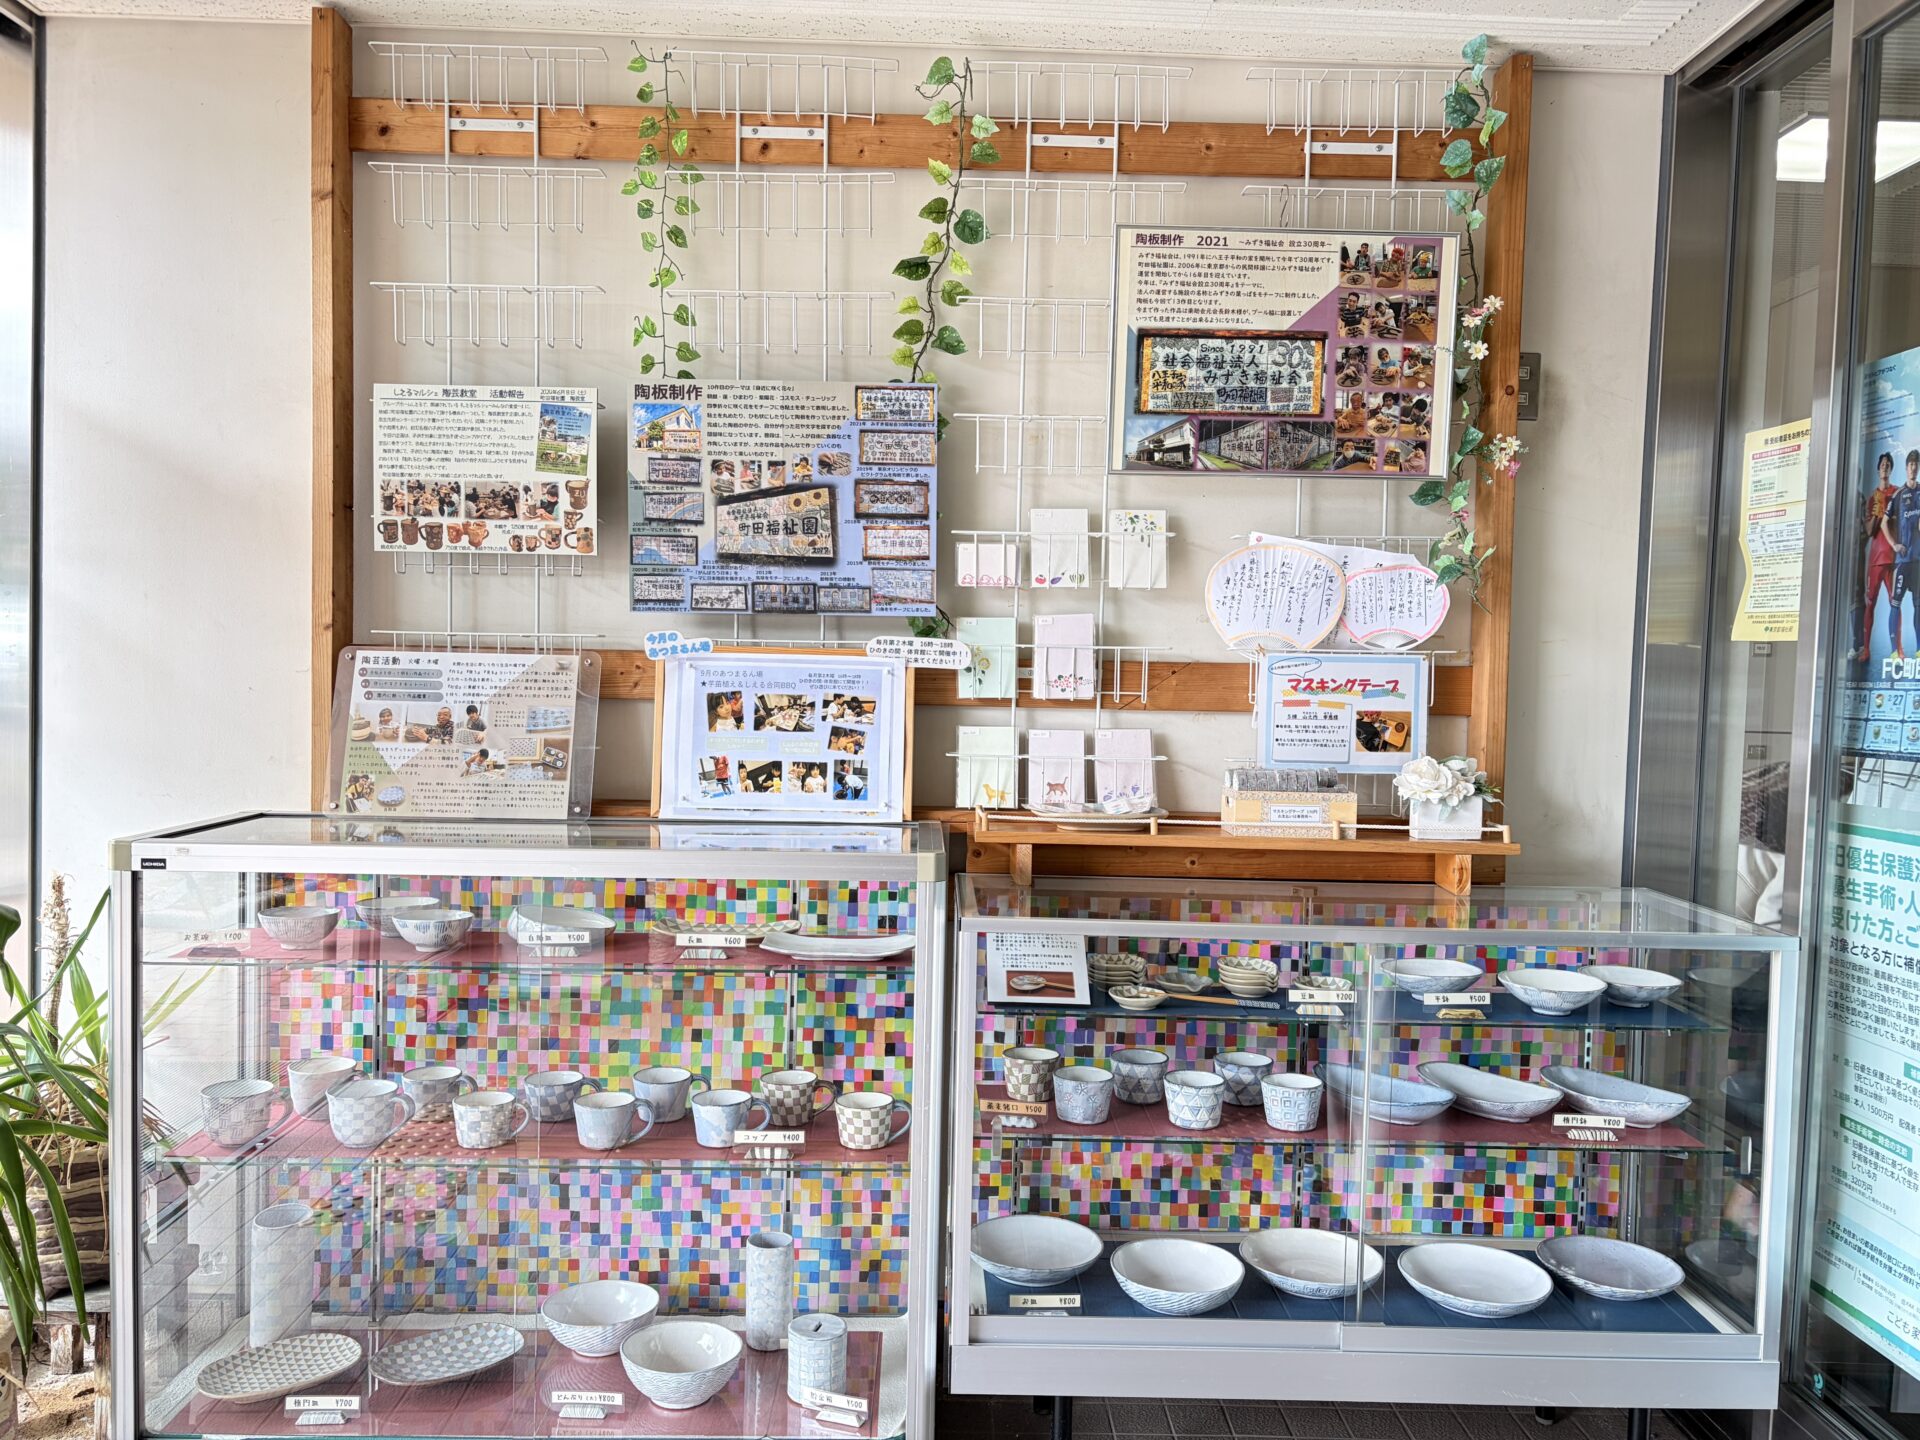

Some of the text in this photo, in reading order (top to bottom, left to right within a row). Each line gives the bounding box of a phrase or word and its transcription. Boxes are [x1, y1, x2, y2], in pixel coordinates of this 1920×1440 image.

[1136, 233, 1185, 246] 陶板制作
[1197, 236, 1229, 247] 2021
[1200, 344, 1263, 354] Since 1991
[1163, 353, 1260, 370] 社会福祉法人
[1203, 370, 1303, 386] みずき福祉会
[490, 388, 525, 399] 活動報告
[634, 384, 703, 401] 陶板制作
[738, 516, 819, 536] 町田福祉園
[647, 632, 678, 644] 今月の
[648, 641, 711, 657] あつまるん場
[361, 655, 401, 666] 陶芸活動
[1287, 678, 1400, 694] マスキングテープ
[568, 934, 585, 942] ¥500
[725, 937, 742, 945] ¥600
[1337, 993, 1353, 1001] ¥200
[1025, 1104, 1043, 1113] ¥500
[1867, 1103, 1894, 1124] 1500万円
[1603, 1118, 1621, 1126] ¥800
[783, 1133, 800, 1141] ¥400
[1851, 1161, 1877, 1182] している方
[1850, 1175, 1873, 1194] 320万円
[336, 1399, 353, 1407] ¥700
[847, 1399, 863, 1409] ¥500
